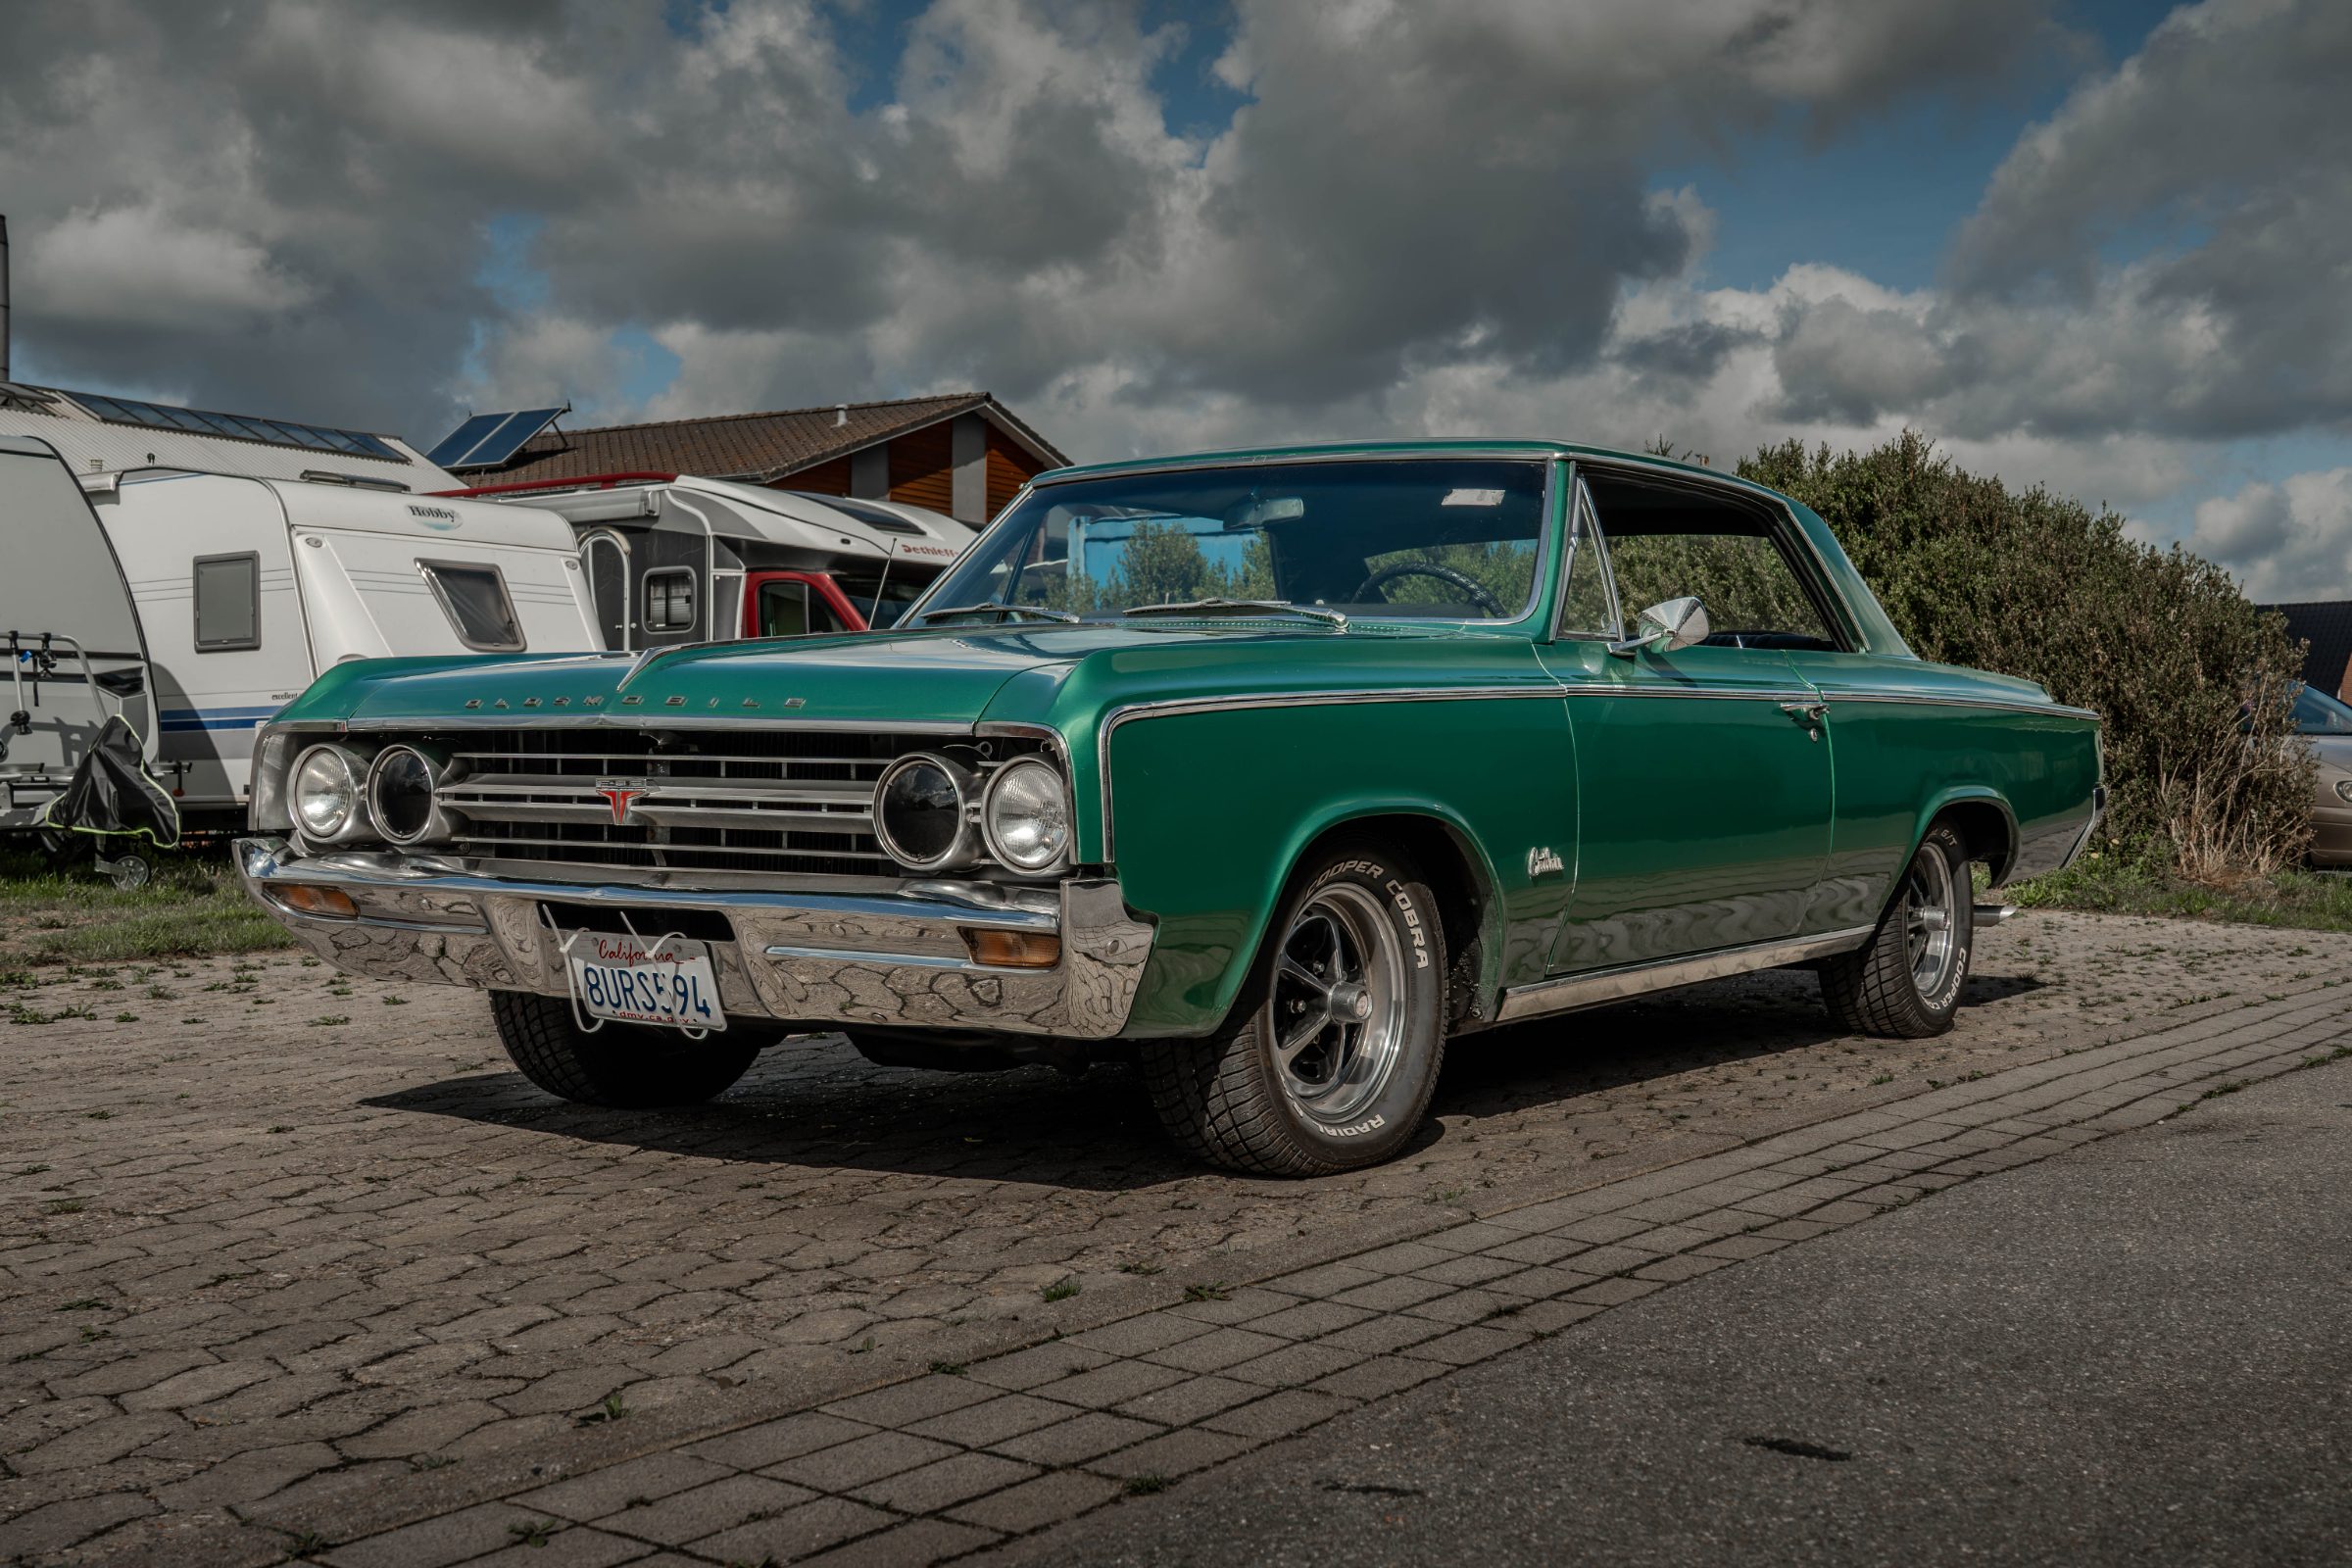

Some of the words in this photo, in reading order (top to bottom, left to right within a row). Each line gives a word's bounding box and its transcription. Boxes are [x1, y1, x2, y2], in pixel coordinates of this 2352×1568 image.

[408, 506, 456, 522] Hobby
[465, 696, 806, 710] OLDSMOBILE
[1304, 859, 1385, 900] COOPER
[1386, 879, 1429, 969] COBRA
[1939, 947, 1966, 1007] COOPER
[584, 967, 711, 1017] 8URS594
[618, 1010, 689, 1023] dmv.ca.gv
[1312, 1113, 1386, 1137] RADIAL
